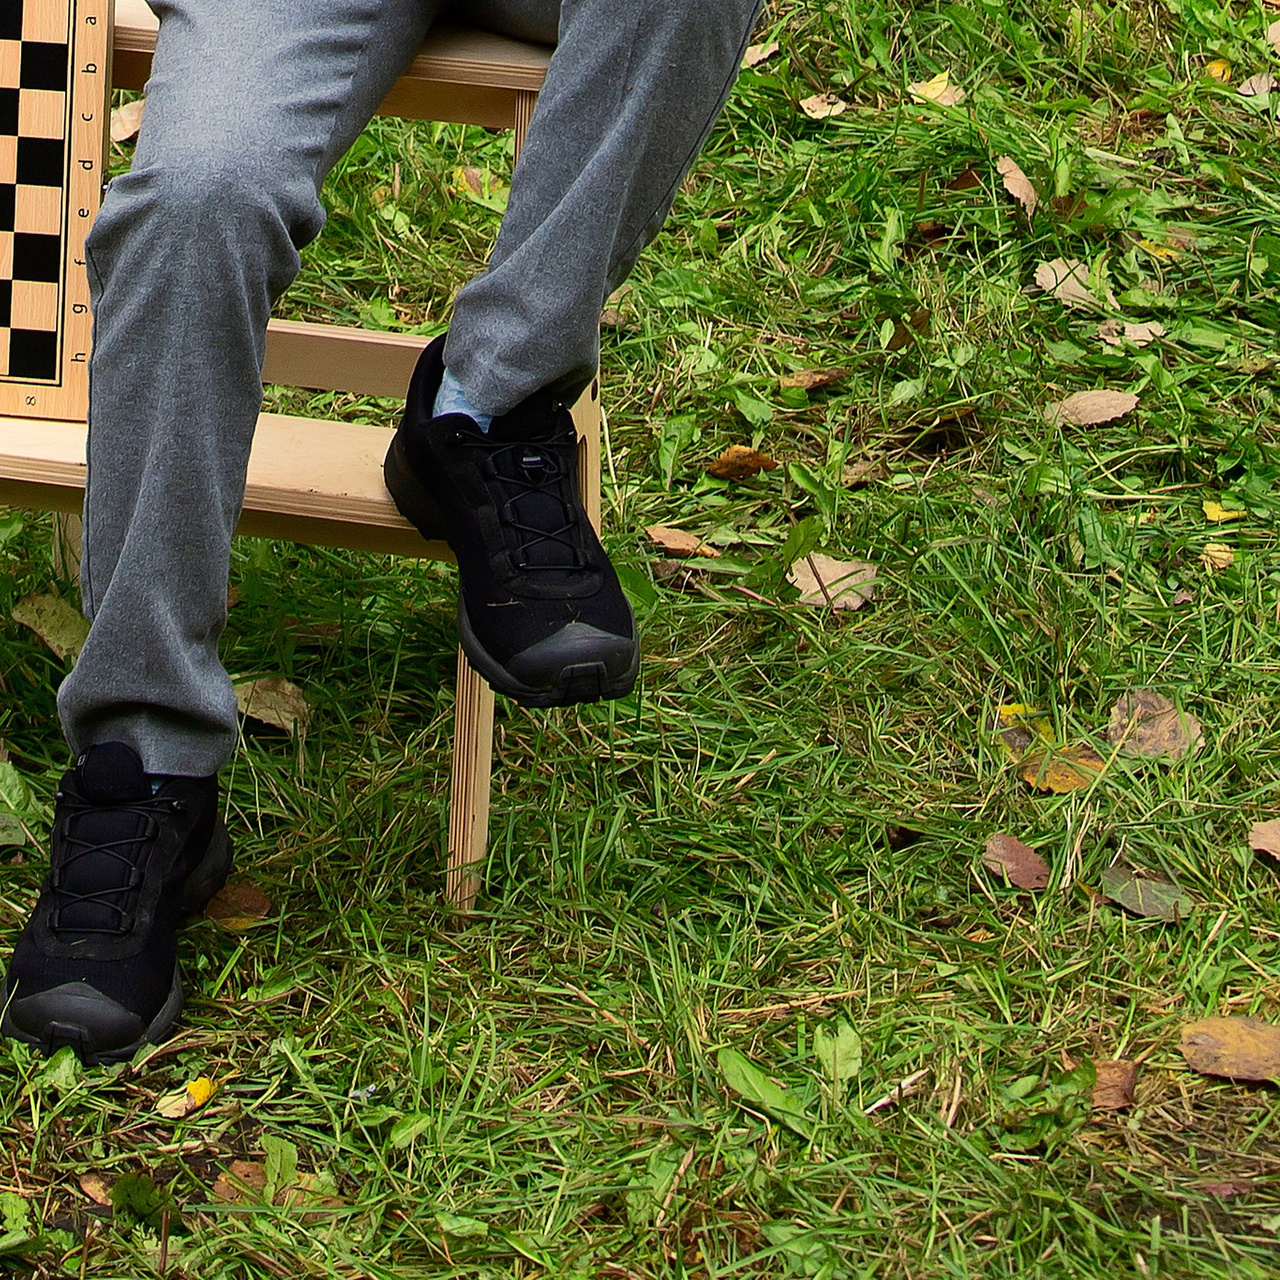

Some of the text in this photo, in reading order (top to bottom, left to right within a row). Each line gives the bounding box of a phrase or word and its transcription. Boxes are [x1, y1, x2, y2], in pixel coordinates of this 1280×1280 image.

[85, 16, 98, 26] a
[81, 62, 98, 74] b
[81, 112, 93, 122] c
[77, 159, 94, 171] d
[77, 208, 90, 218] e
[72, 303, 88, 314] g
[70, 352, 87, 363] h
[25, 395, 37, 406] 8
